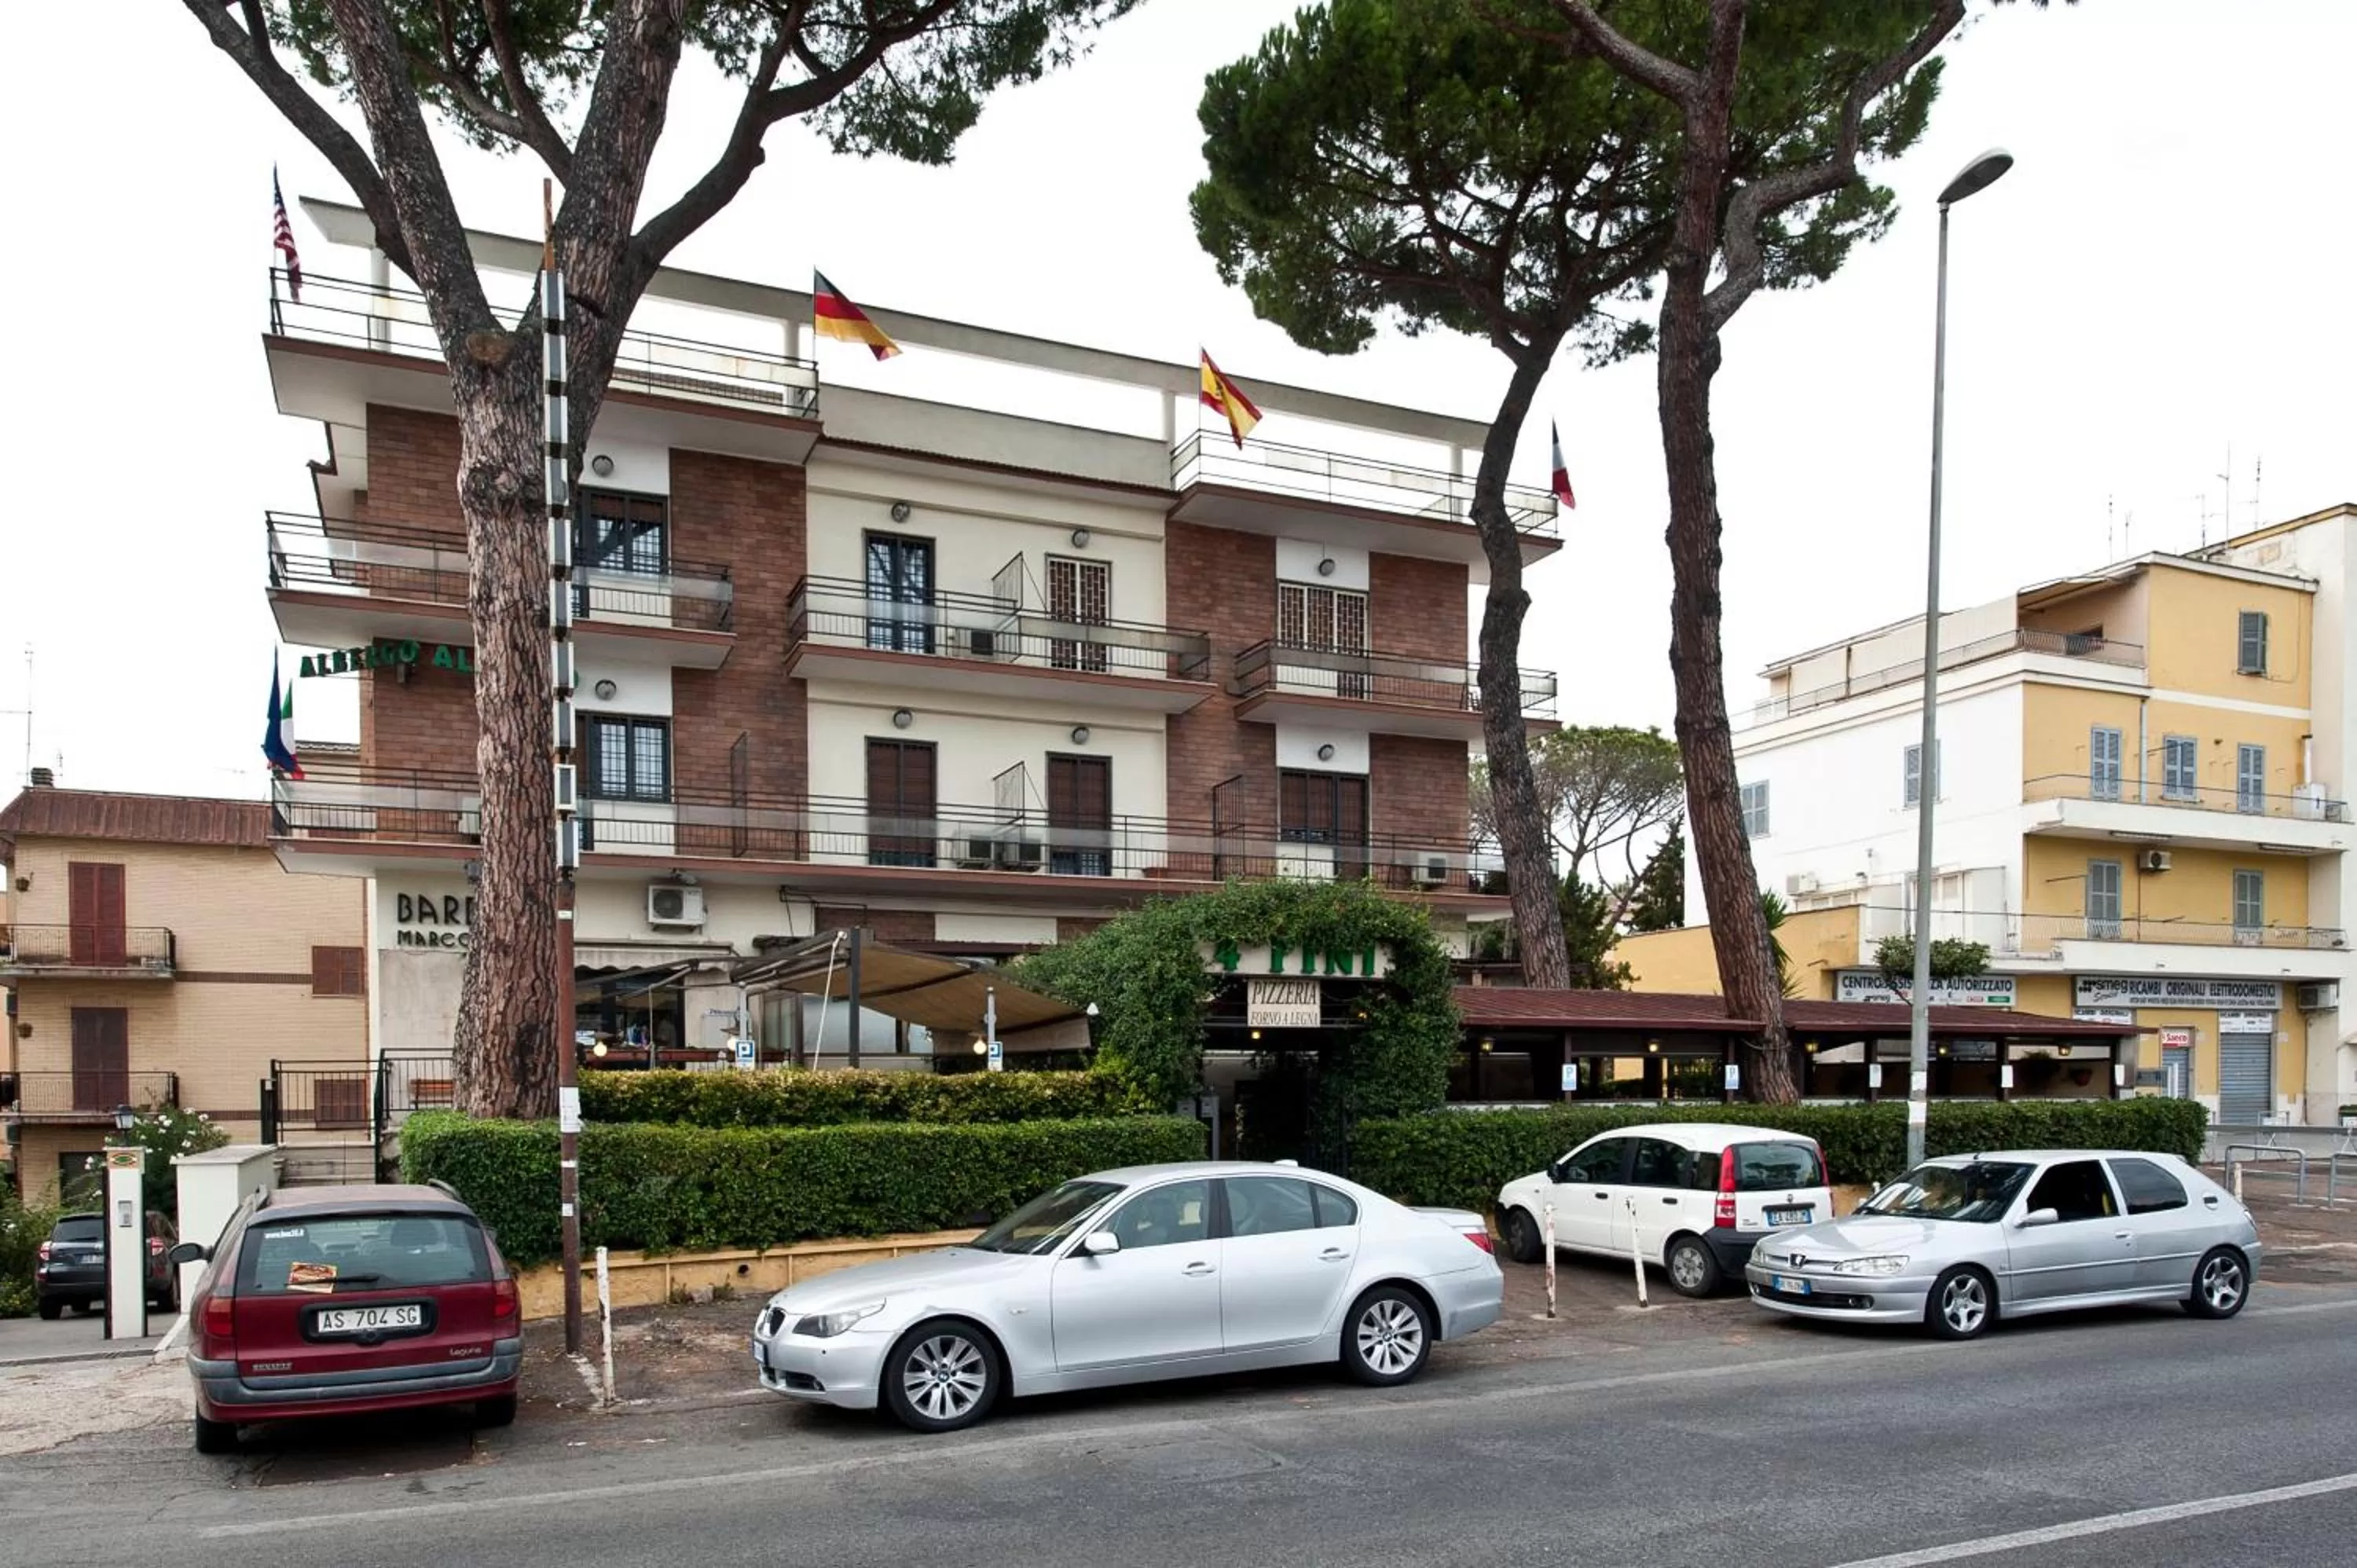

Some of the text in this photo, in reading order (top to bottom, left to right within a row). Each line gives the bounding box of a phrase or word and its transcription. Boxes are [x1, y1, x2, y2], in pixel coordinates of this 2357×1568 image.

[300, 639, 420, 677] ALBERGO
[1252, 980, 1316, 1005] PIZZERIA
[1842, 976, 1882, 989] CENTRO
[1947, 977, 2013, 992] AUTORIZZATO
[2129, 980, 2161, 995] RICAMBI
[2166, 982, 2205, 996] ORIGINALI
[2209, 982, 2276, 998] ELETTRODOMESTICI
[1250, 1011, 1281, 1025] FORNO
[323, 1306, 417, 1329] AS 704 SG
